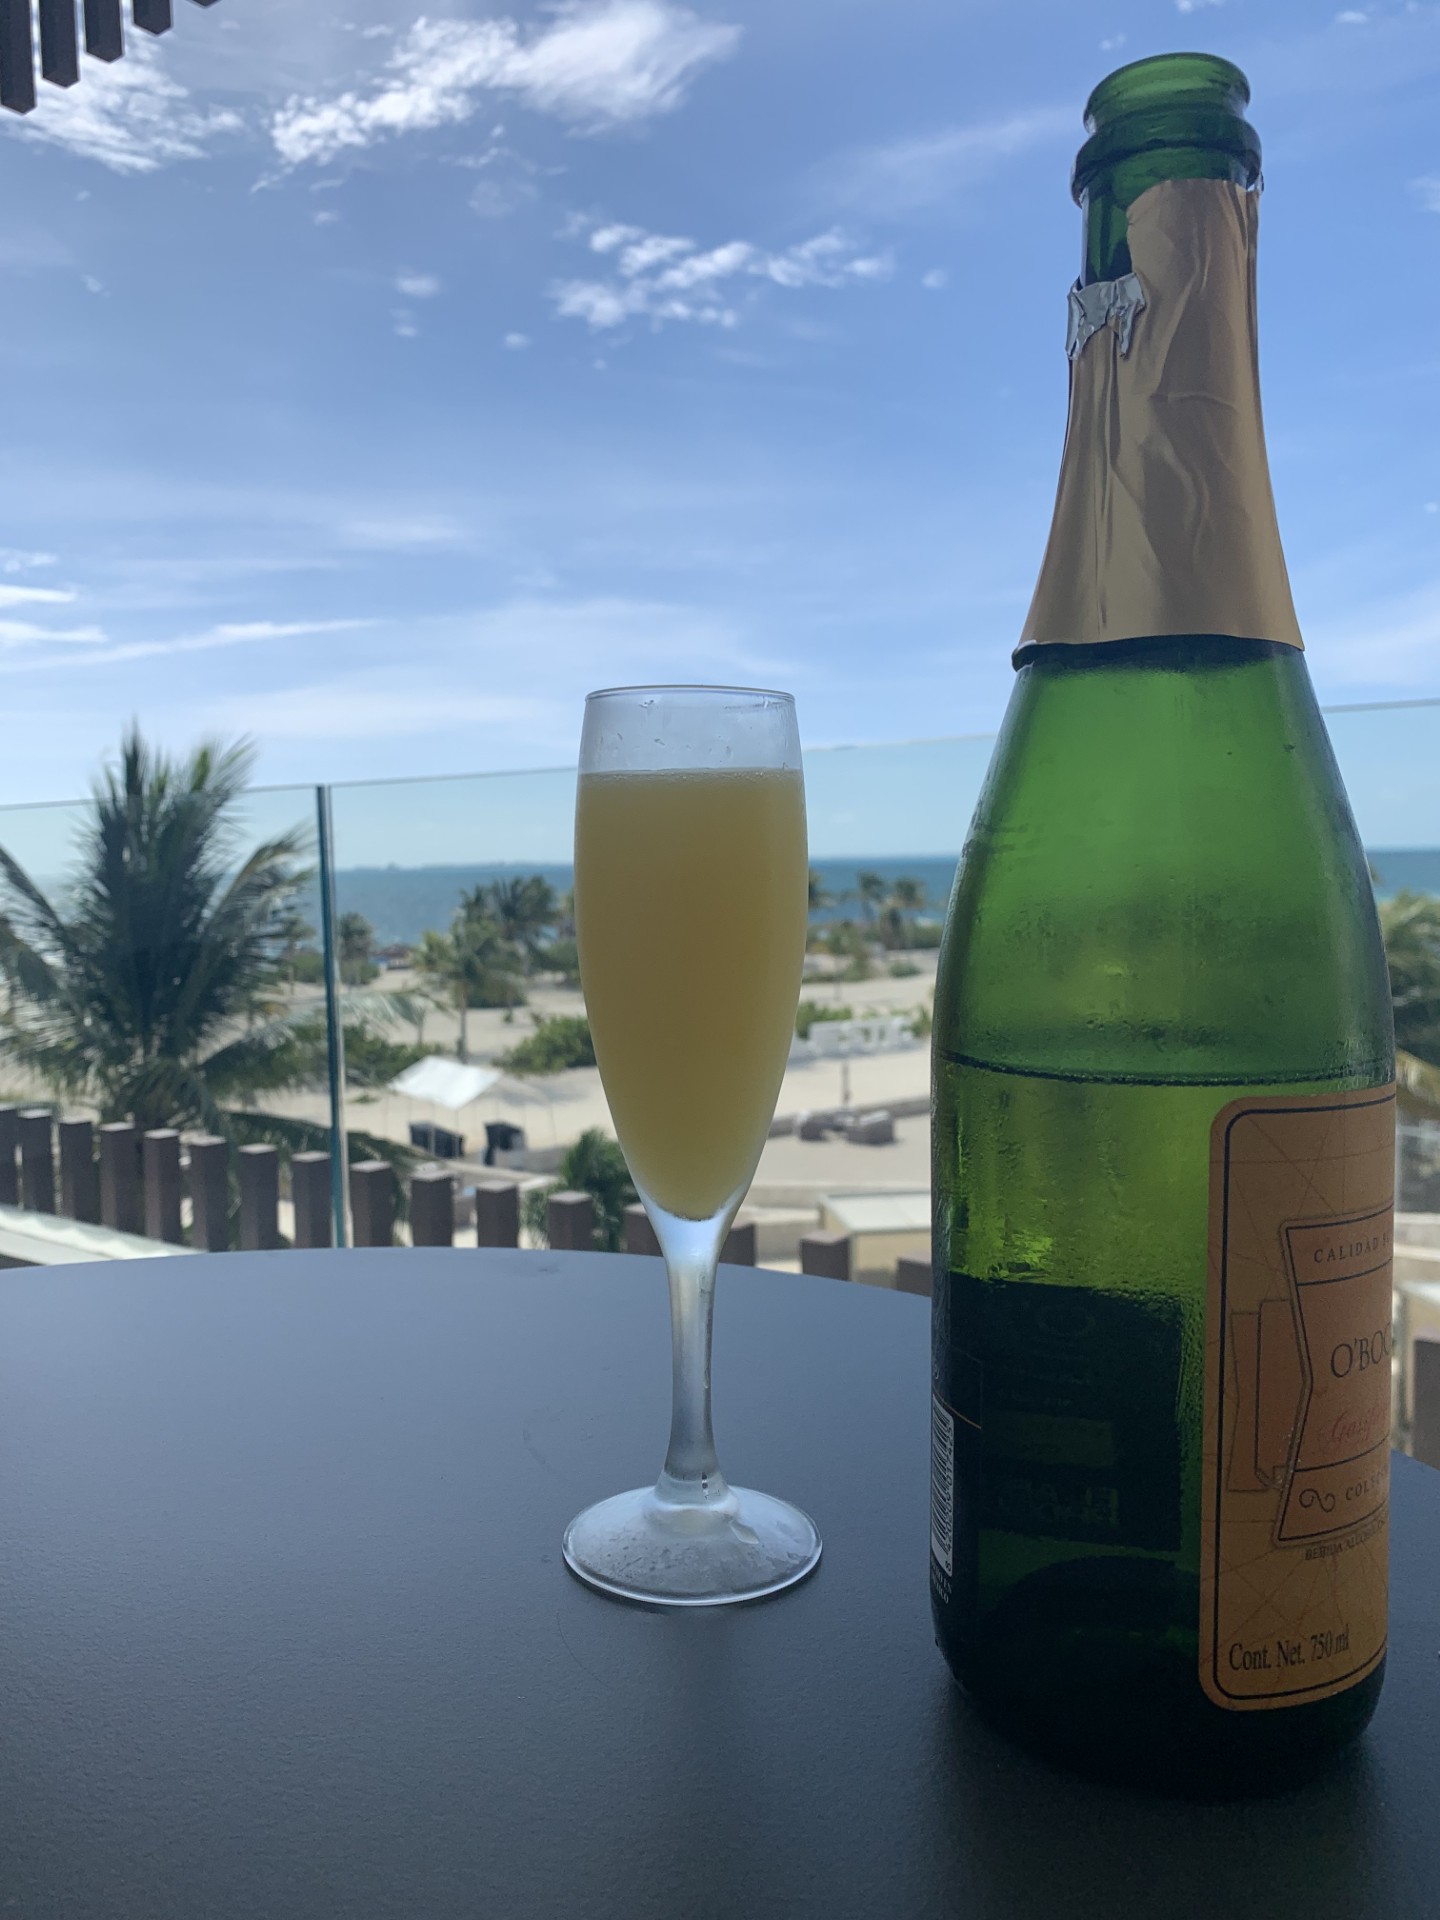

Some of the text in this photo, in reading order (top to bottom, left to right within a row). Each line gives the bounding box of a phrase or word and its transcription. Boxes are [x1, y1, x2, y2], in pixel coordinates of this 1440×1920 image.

[1313, 1237, 1378, 1263] CALIDAD
[1229, 1623, 1350, 1670] Cont. Net. 750 ml
